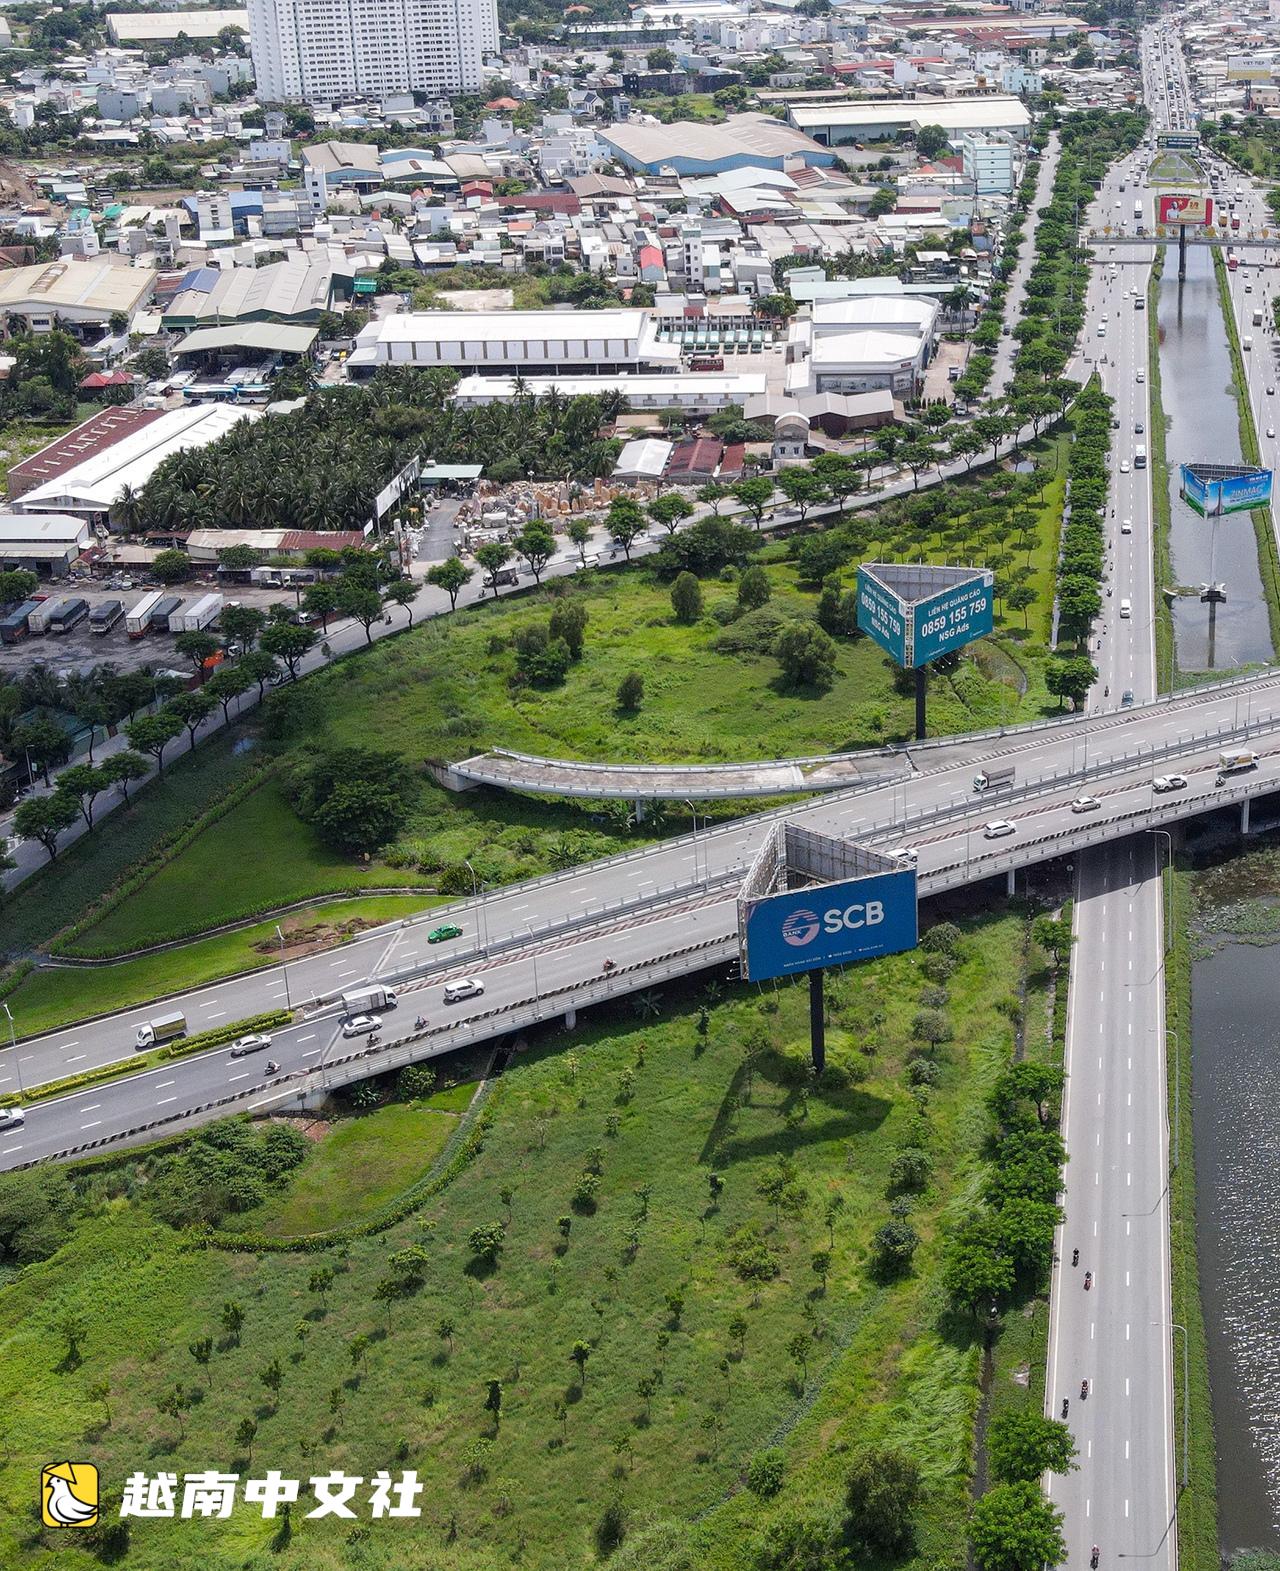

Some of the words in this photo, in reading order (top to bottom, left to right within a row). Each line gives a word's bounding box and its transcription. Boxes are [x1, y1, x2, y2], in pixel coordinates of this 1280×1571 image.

[969, 588, 981, 598] CÁO
[861, 591, 876, 614] 0859
[877, 605, 888, 625] 155
[889, 615, 901, 636] 759
[922, 615, 946, 638] 0859
[949, 606, 967, 624] 155
[969, 597, 986, 616] 759
[939, 628, 955, 642] NSG
[956, 622, 970, 635] Ads
[823, 901, 885, 934] SCB
[783, 930, 802, 938] BANK
